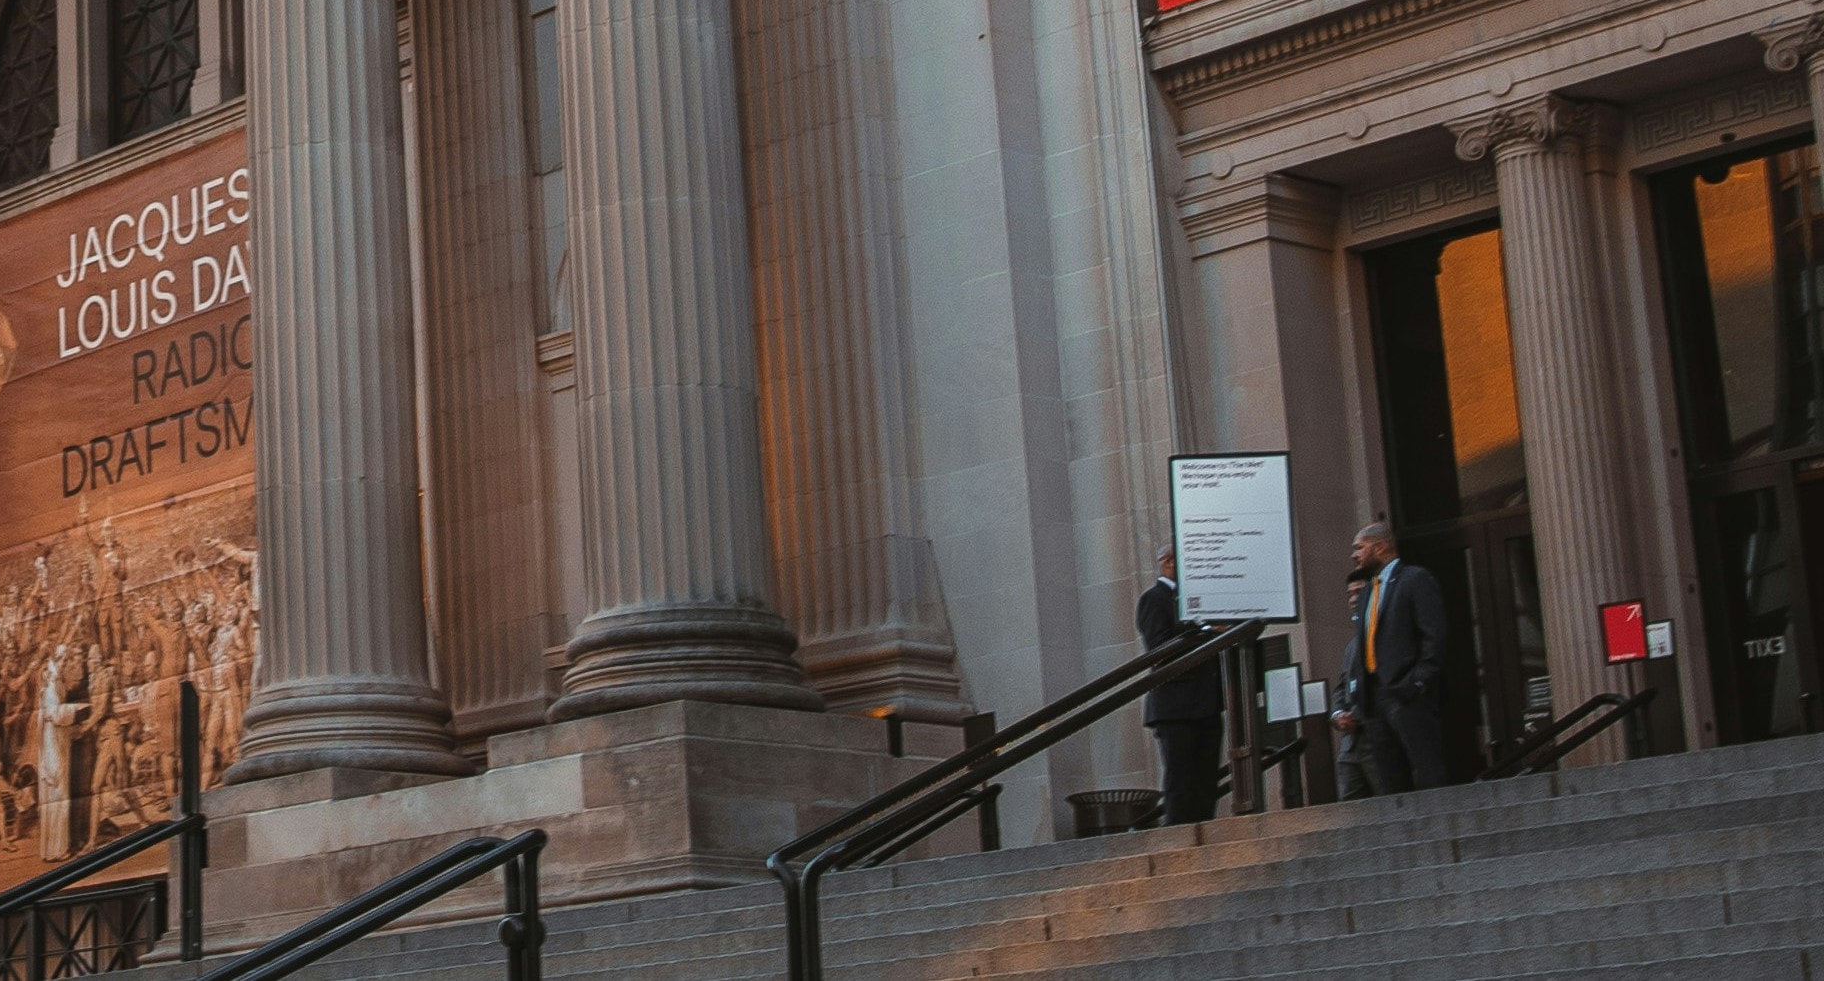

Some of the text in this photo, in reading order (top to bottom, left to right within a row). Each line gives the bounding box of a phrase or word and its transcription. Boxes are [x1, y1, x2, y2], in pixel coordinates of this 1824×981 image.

[56, 168, 250, 289] JACQUES
[58, 240, 251, 359] LOUIS DA
[62, 394, 255, 498] DRAFTSM
